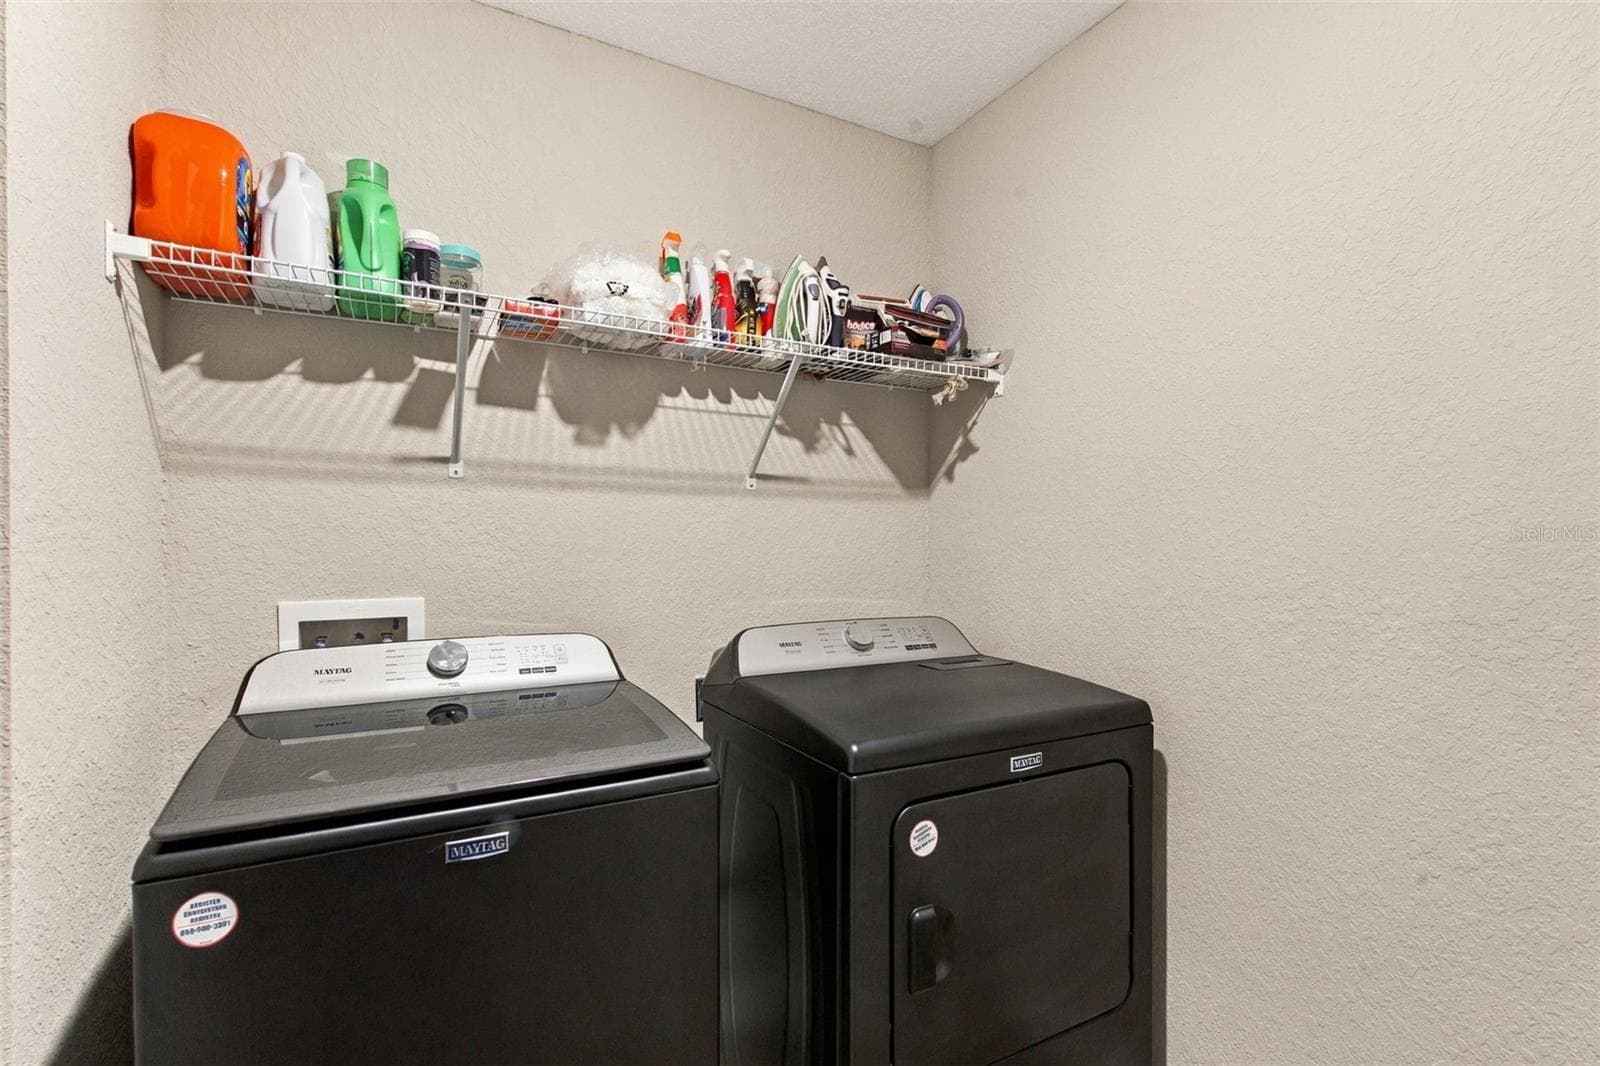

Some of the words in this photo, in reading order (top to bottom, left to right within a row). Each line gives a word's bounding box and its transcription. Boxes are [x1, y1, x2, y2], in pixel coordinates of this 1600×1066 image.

[313, 667, 352, 676] MAYTAG
[1013, 755, 1041, 768] MAYTAG
[451, 838, 505, 858] MAYTAG
